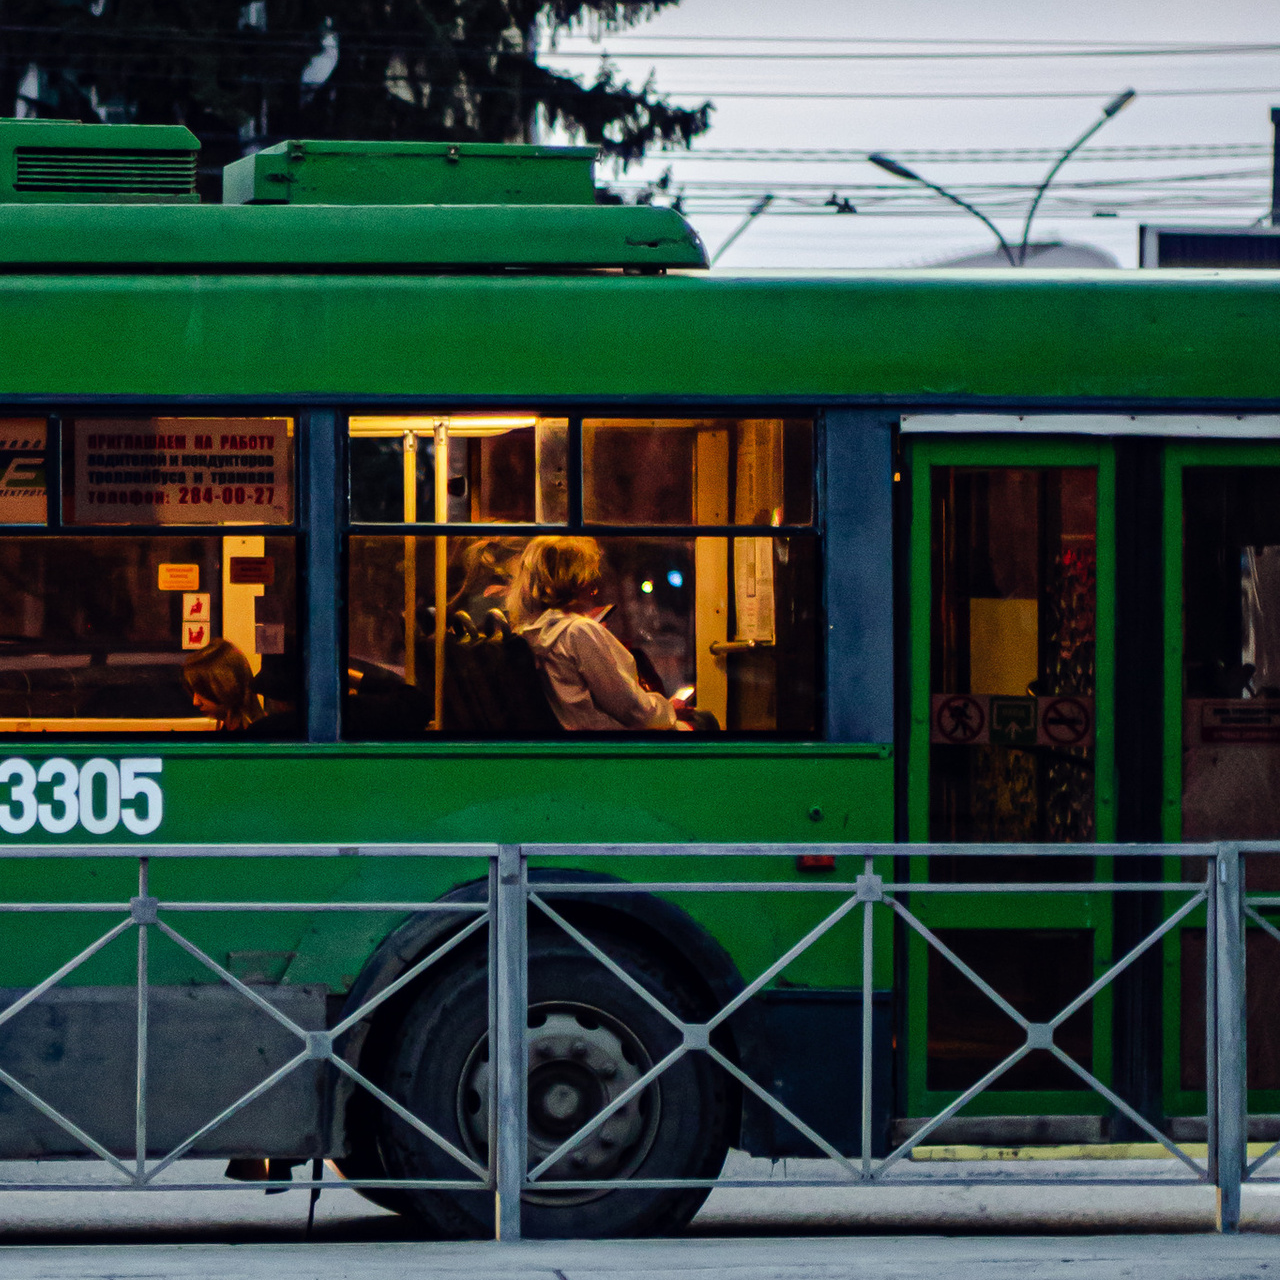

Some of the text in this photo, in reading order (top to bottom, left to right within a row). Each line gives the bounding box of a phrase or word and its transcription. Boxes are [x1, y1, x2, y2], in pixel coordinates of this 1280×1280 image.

[88, 435, 275, 449] ПРИГЛАШАЕМ НА РАБОТУ
[170, 456, 178, 466] и
[182, 456, 274, 468] кондукторов
[194, 472, 202, 483] и
[179, 487, 275, 504] 284-00-27
